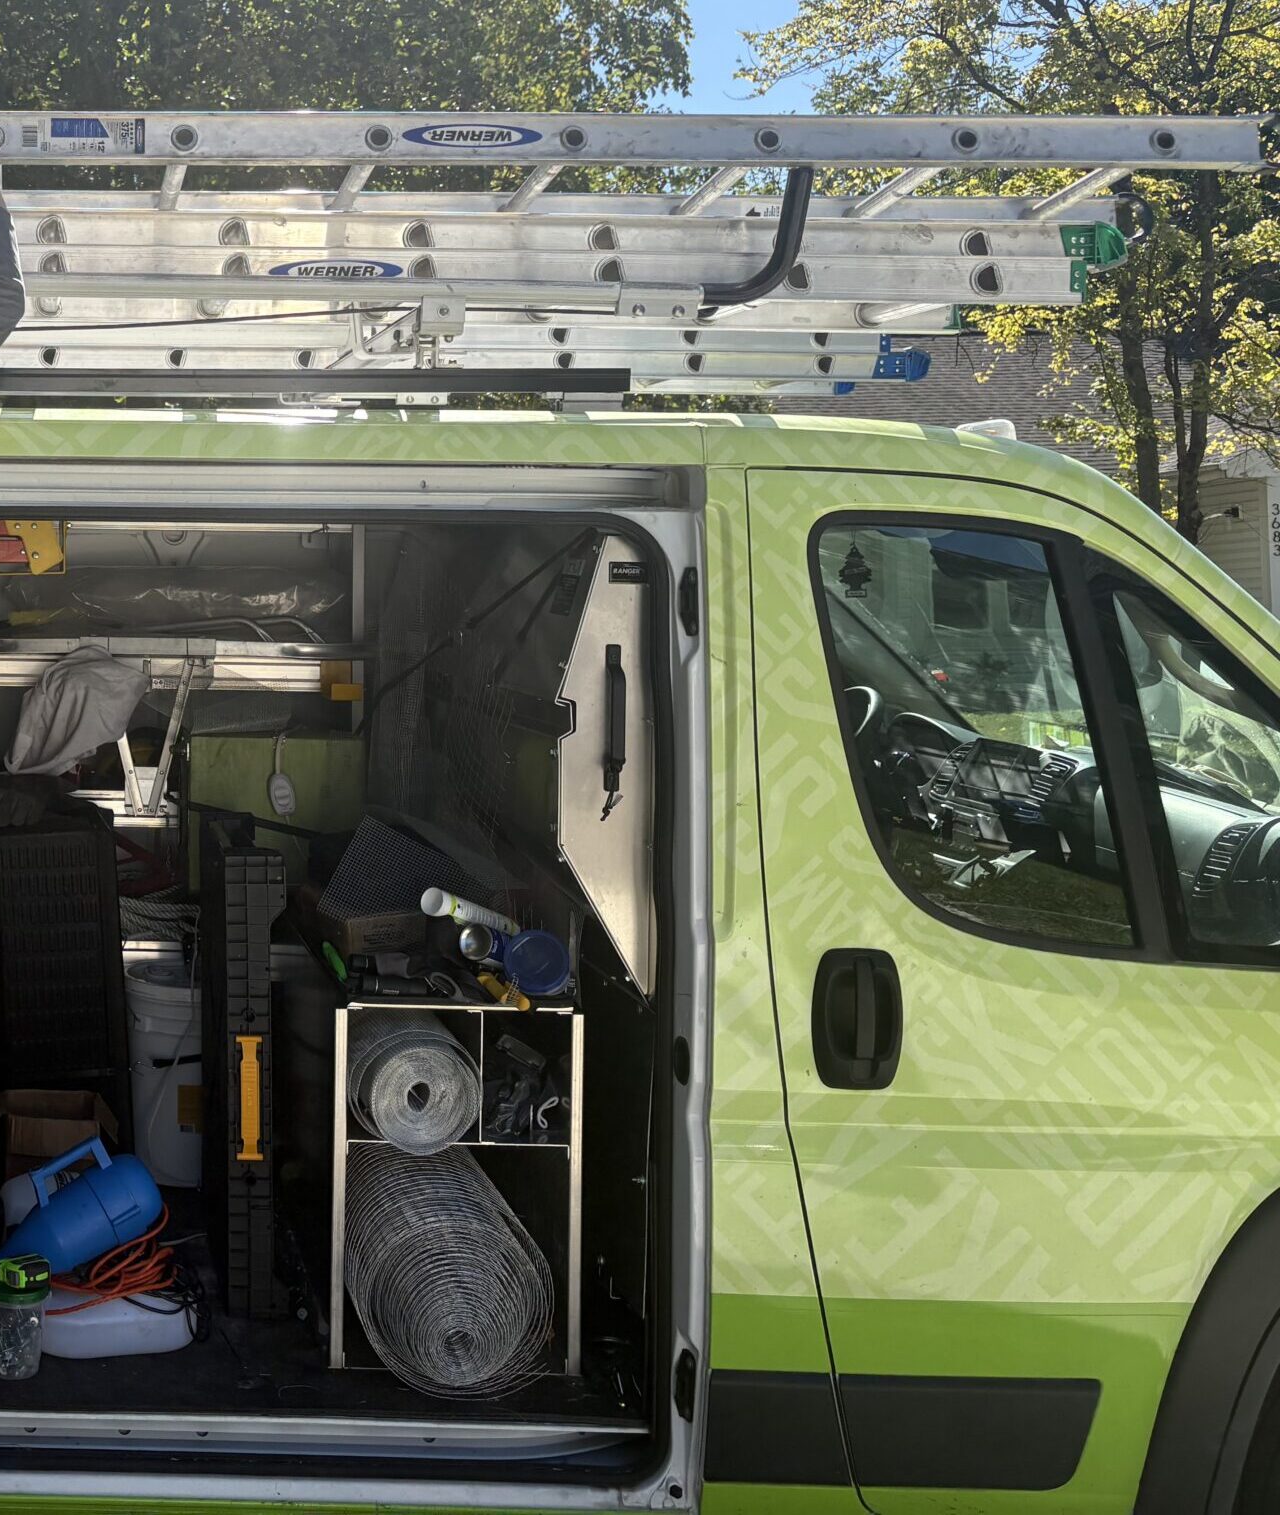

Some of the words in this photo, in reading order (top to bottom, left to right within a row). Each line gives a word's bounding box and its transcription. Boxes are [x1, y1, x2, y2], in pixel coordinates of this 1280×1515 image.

[431, 130, 512, 142] WERNER
[297, 265, 376, 277] WERNER
[612, 567, 641, 575] RANGER
